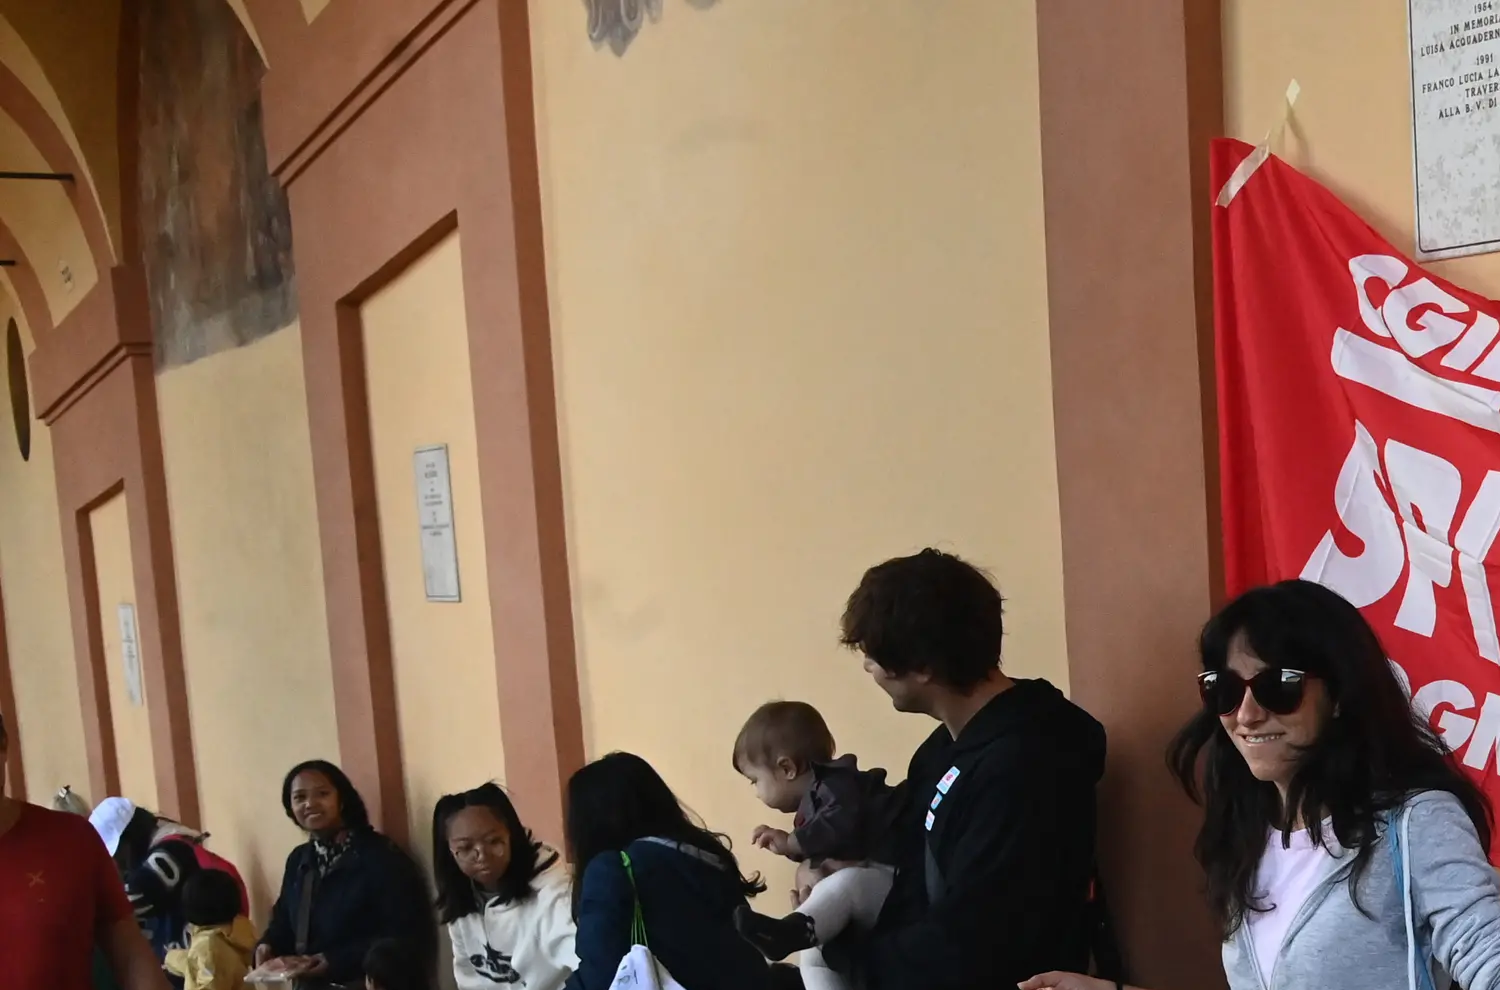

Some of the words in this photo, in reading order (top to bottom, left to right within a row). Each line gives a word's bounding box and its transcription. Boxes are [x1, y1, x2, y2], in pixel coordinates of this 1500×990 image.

[1450, 23, 1460, 35] IN
[1420, 42, 1445, 57] LUISA
[1476, 53, 1494, 65] 1991
[1422, 77, 1455, 94] FRANCO
[1459, 71, 1484, 85] LUCIA
[1438, 105, 1461, 119] ALLA
[1465, 103, 1473, 114] B.
[1476, 100, 1485, 111] V.
[1488, 98, 1497, 109] DI
